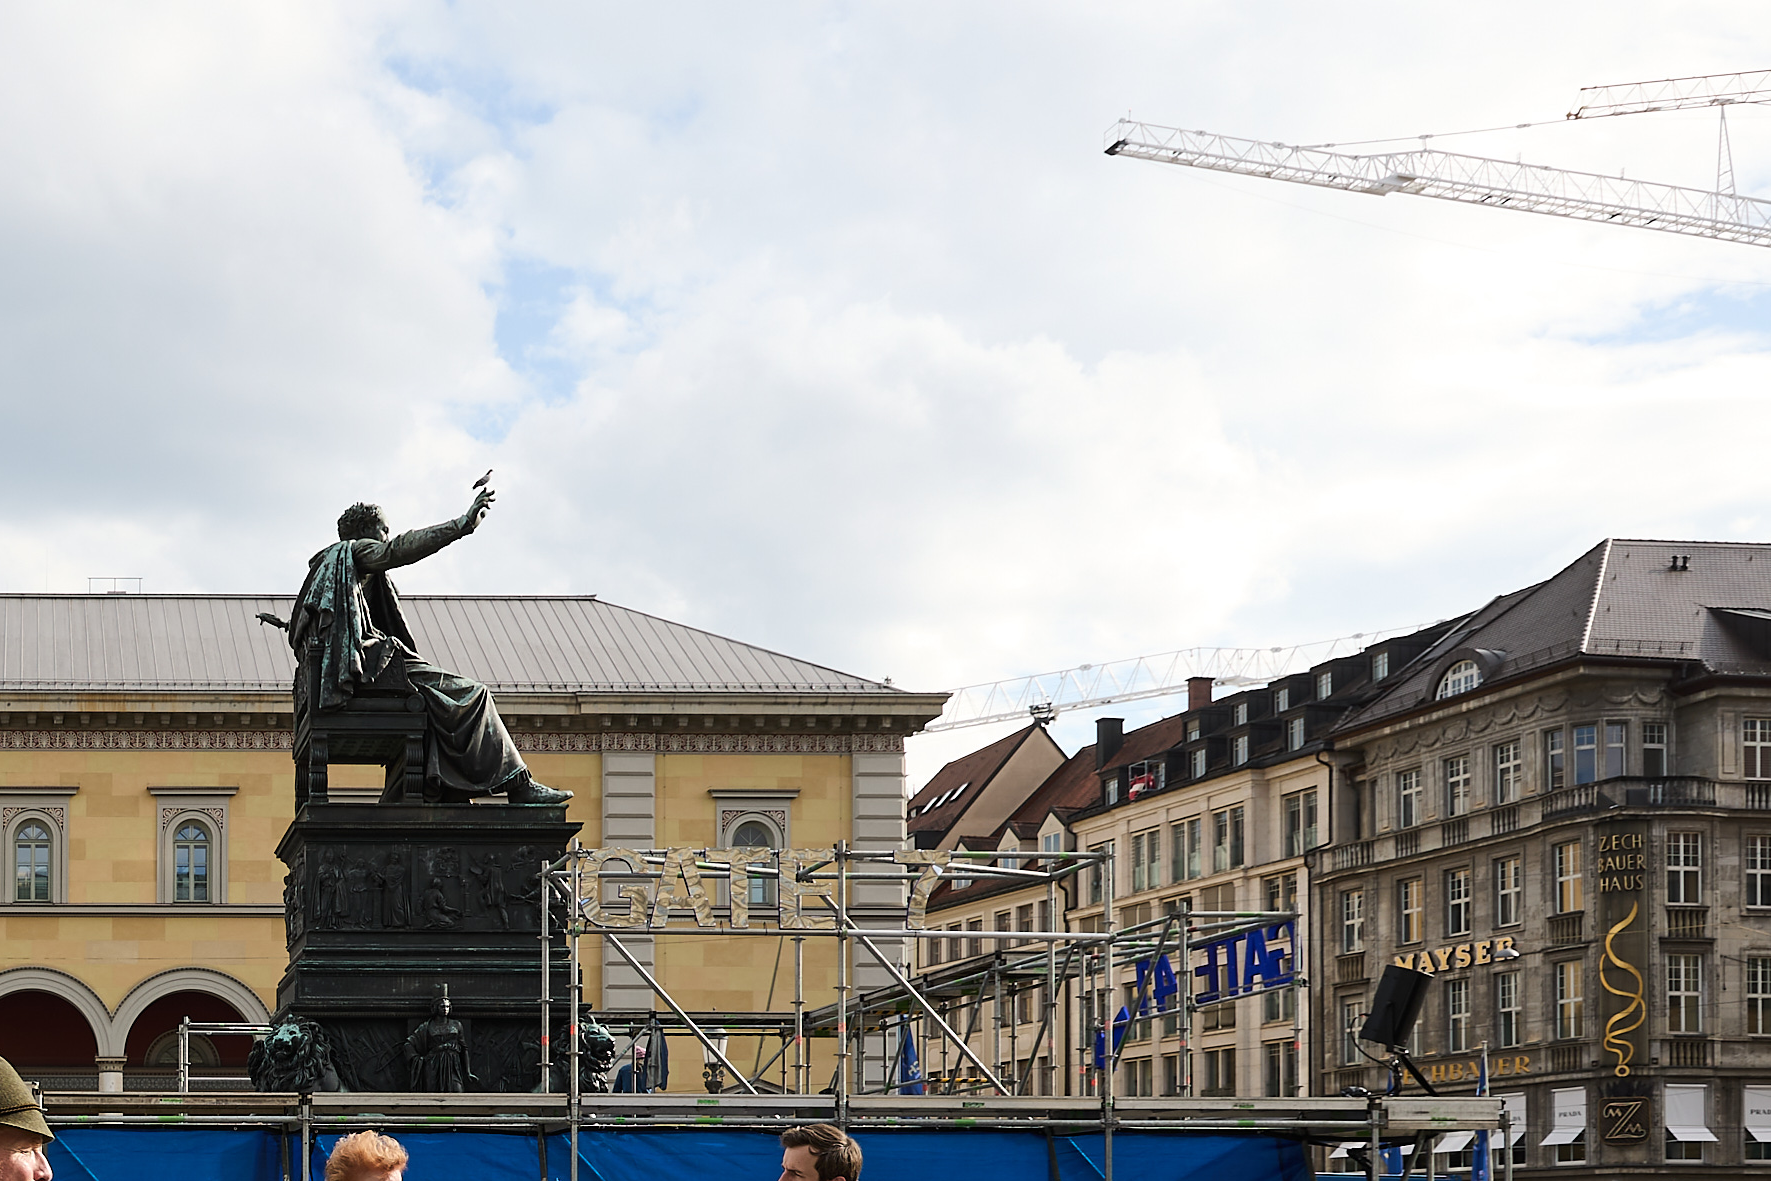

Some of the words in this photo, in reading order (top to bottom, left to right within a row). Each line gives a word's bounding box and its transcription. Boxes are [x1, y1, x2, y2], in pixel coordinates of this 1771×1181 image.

[1599, 834, 1642, 852] ZECH
[1597, 854, 1647, 873] BAUER
[580, 847, 837, 929] GATE
[893, 850, 951, 930] 7
[1600, 875, 1644, 892] HAUS
[1558, 1110, 1582, 1119] PRADA
